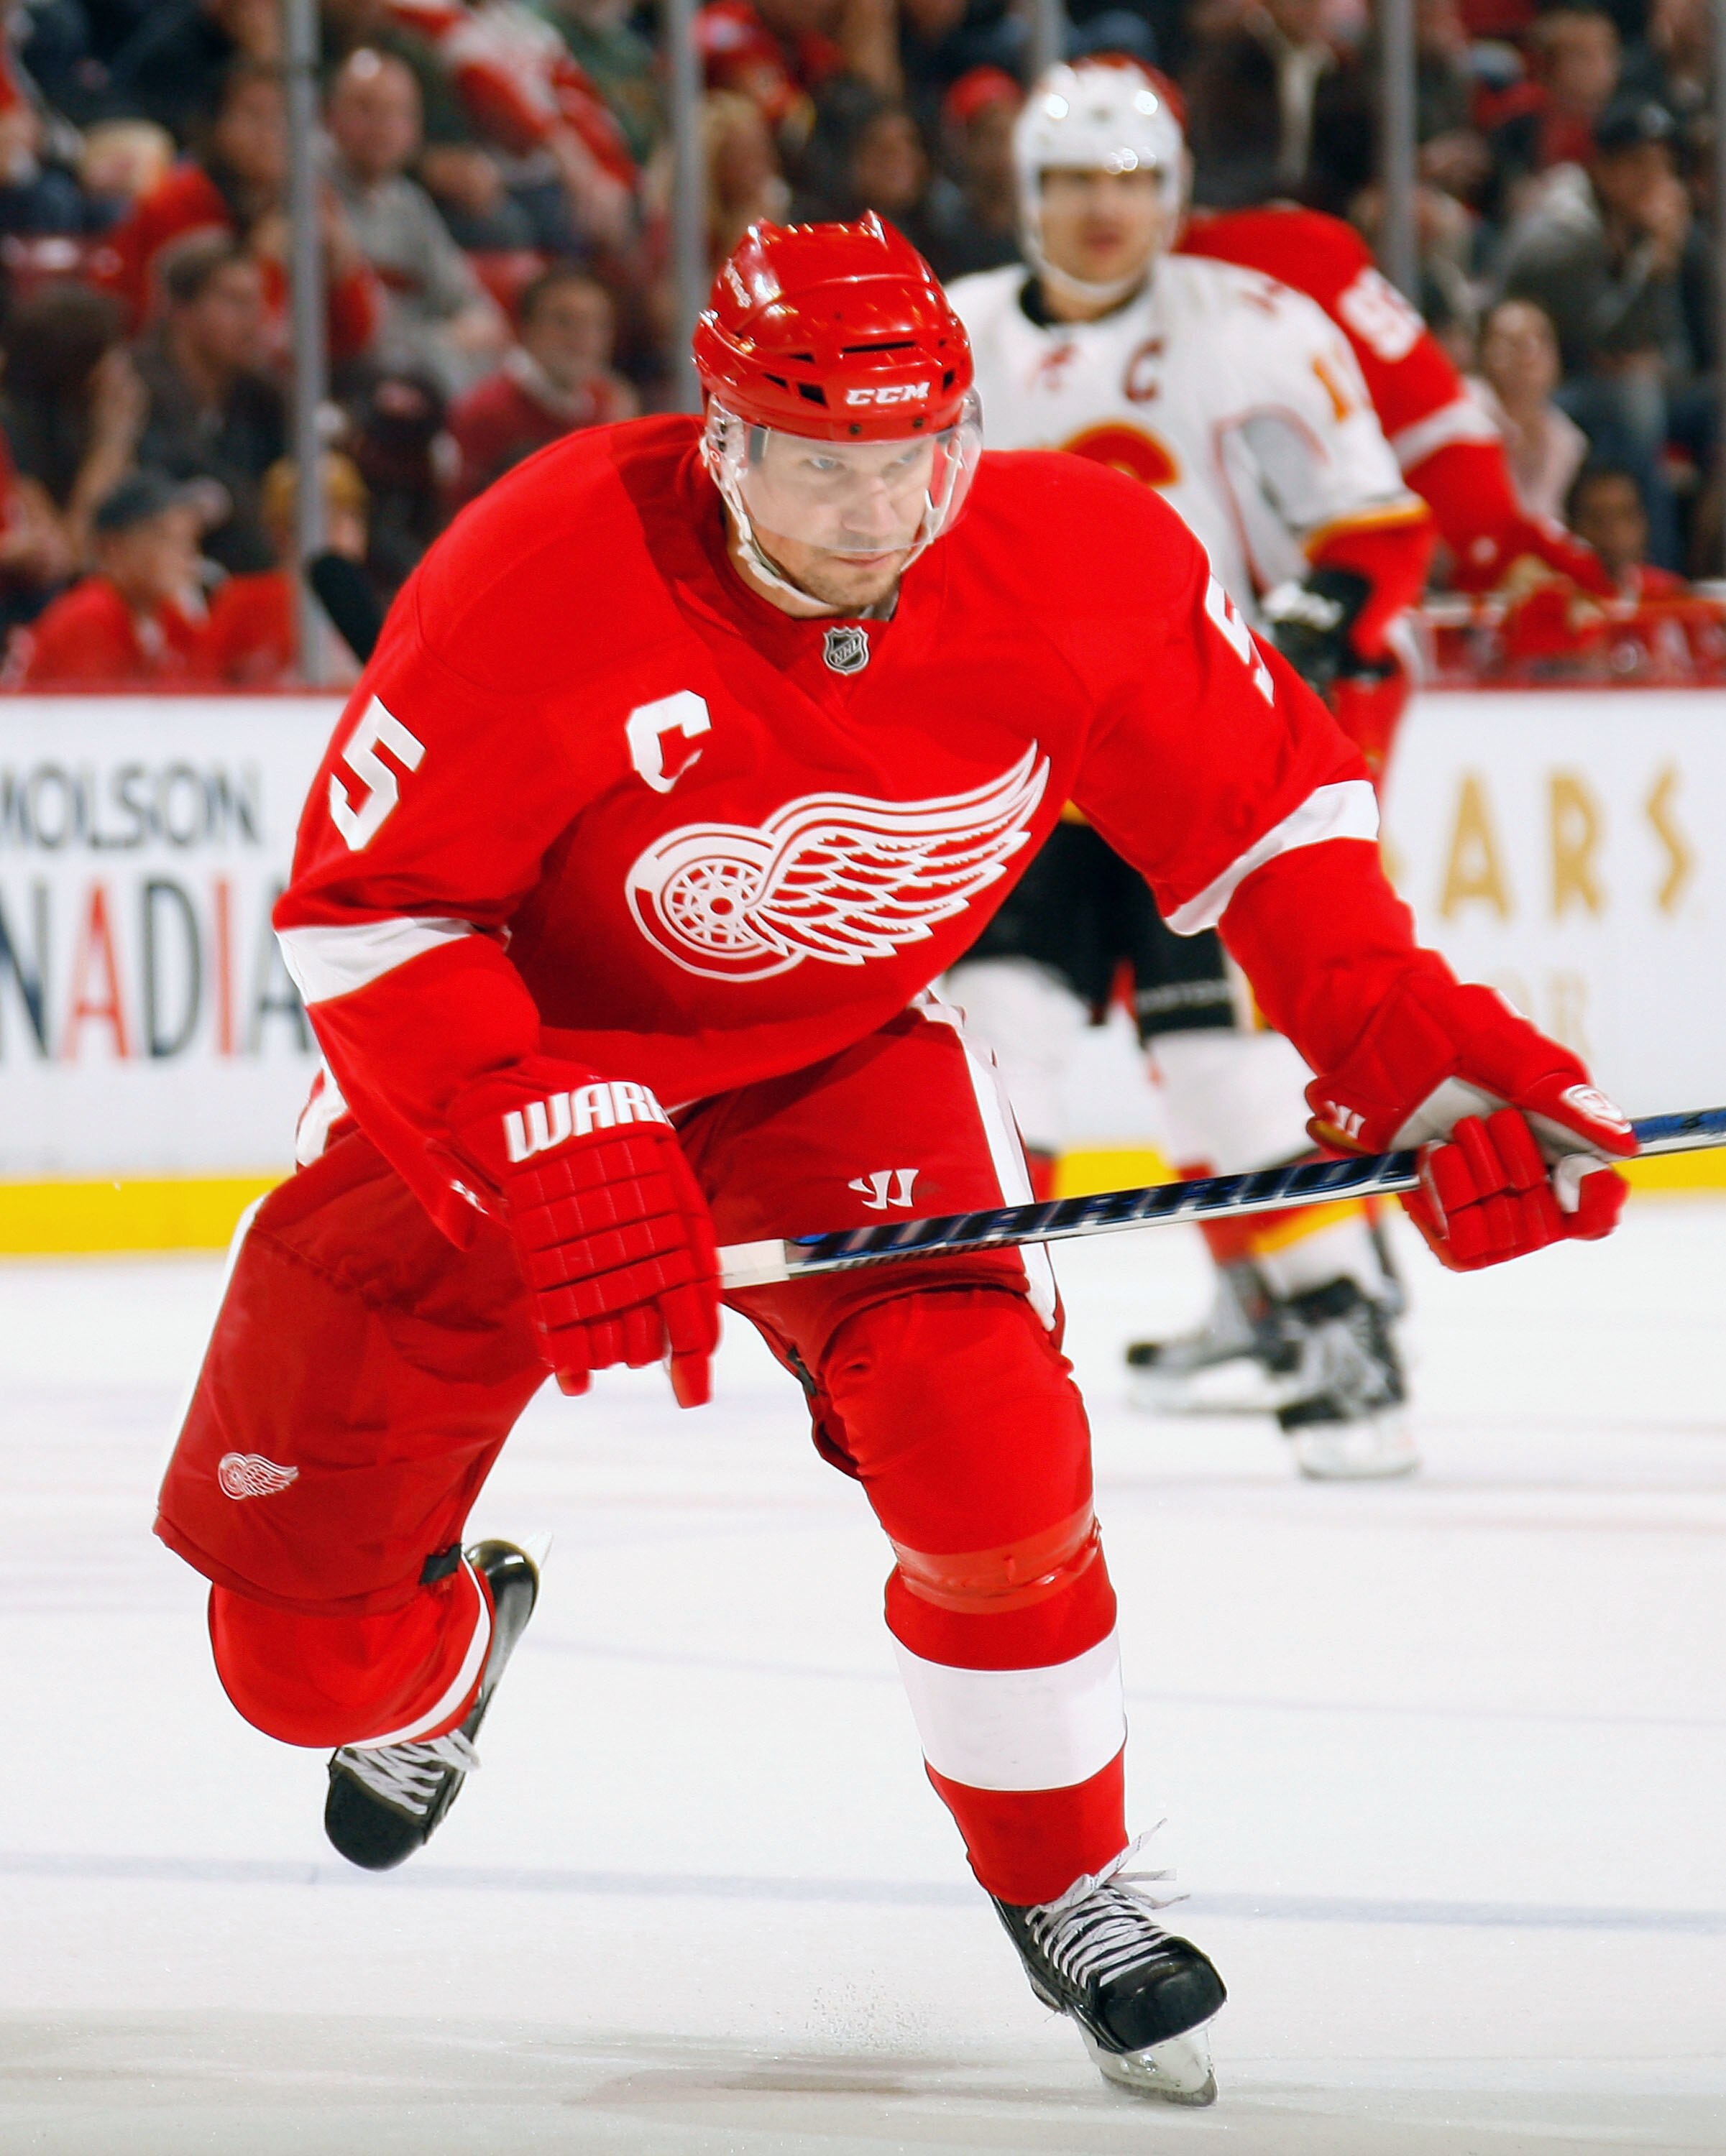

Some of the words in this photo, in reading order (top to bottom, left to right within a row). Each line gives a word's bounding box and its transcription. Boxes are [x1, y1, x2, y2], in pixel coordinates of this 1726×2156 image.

[845, 381, 931, 405] CCM
[1121, 336, 1168, 404] C
[832, 637, 861, 665] NHL
[329, 694, 426, 852] 5
[625, 688, 712, 793] C
[1384, 762, 1695, 920] ARS
